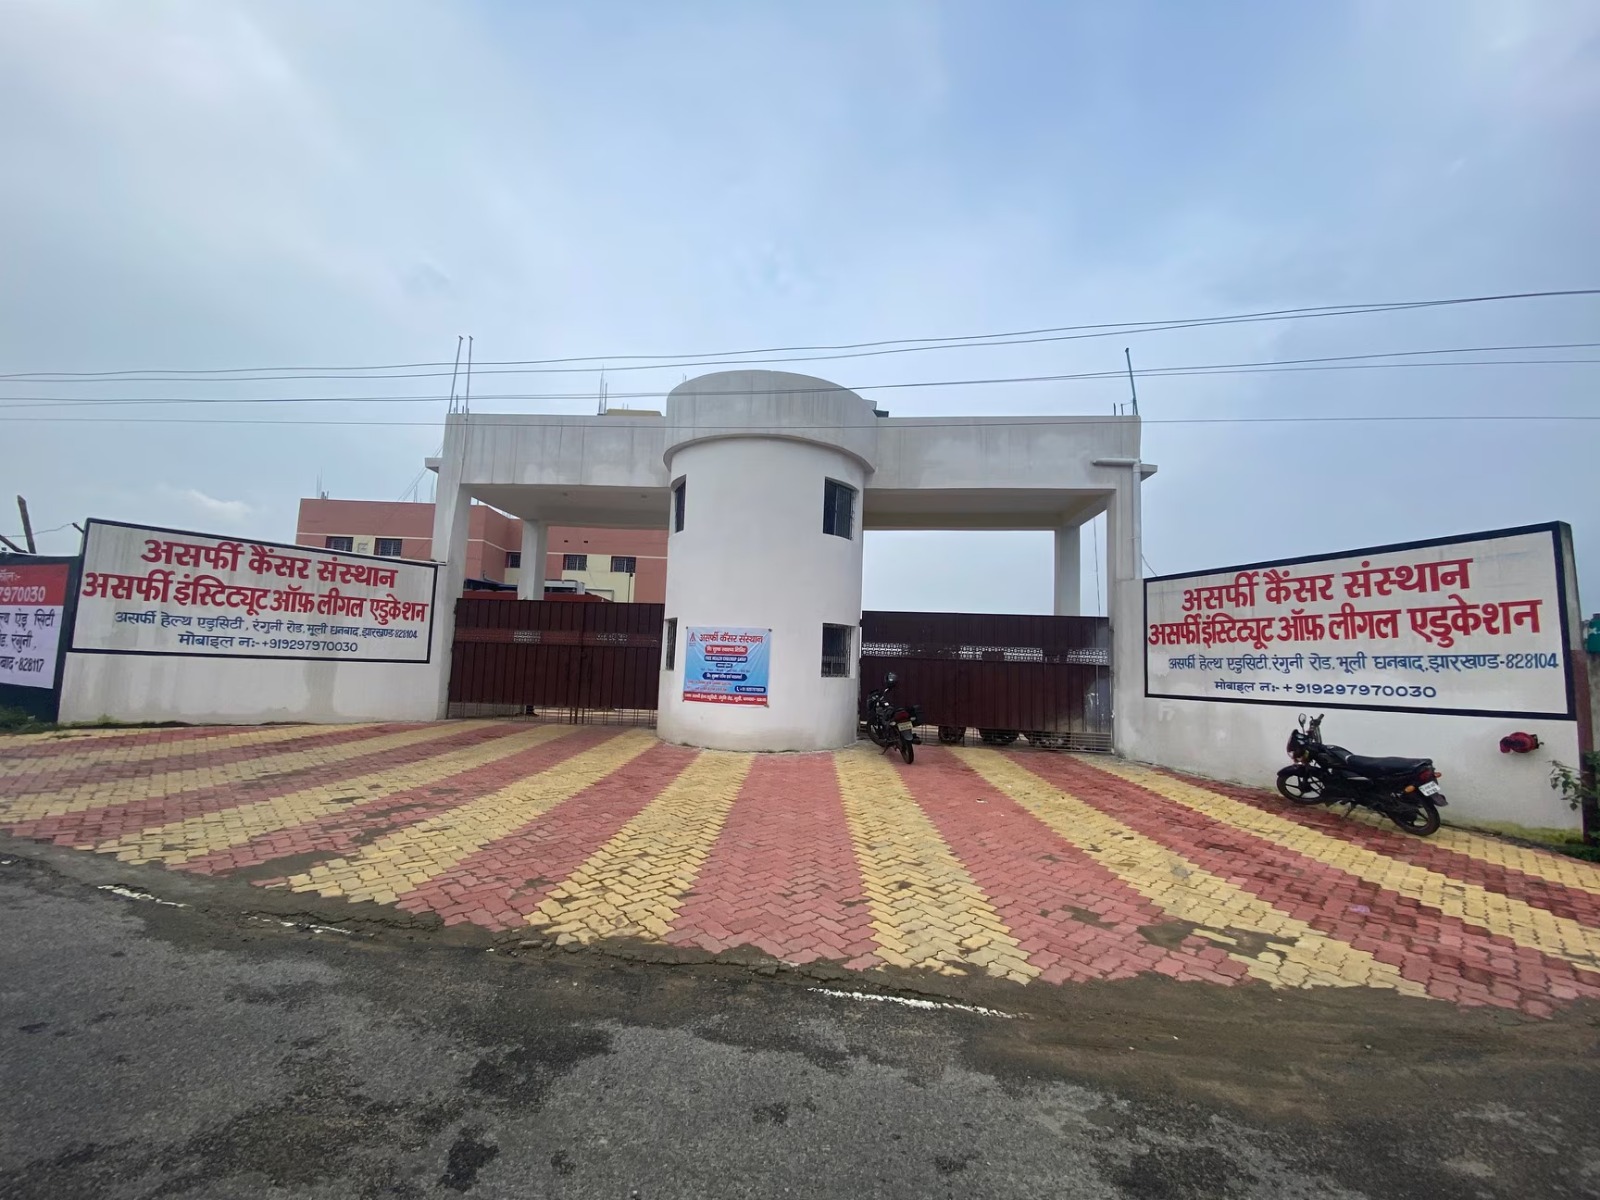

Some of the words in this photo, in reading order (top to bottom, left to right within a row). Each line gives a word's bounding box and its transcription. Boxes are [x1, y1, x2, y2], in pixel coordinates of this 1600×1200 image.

[141, 539, 245, 572] असर्फी
[248, 544, 312, 580] कैंसर
[317, 556, 398, 589] संस्थान
[82, 569, 176, 603] असर्फी
[316, 587, 367, 618] लीगल
[369, 593, 429, 626] एडुकेशन
[1181, 570, 1260, 612] असर्फी
[1262, 568, 1335, 605] कैंसर
[1341, 557, 1474, 599] संस्थान
[114, 610, 157, 625] असर्फी
[160, 611, 193, 628] हेल्थ
[252, 618, 284, 634] रंगुनी
[177, 630, 236, 649] मोबाइल
[1147, 613, 1202, 646] असर्फी
[1328, 602, 1402, 640] लीगल
[1406, 593, 1543, 649] एडुकेशन
[1168, 653, 1196, 670] असर्फी
[1199, 654, 1224, 671] हेल्थ
[1271, 652, 1304, 674] रंगुनी
[1214, 678, 1256, 694] मोबाइल
